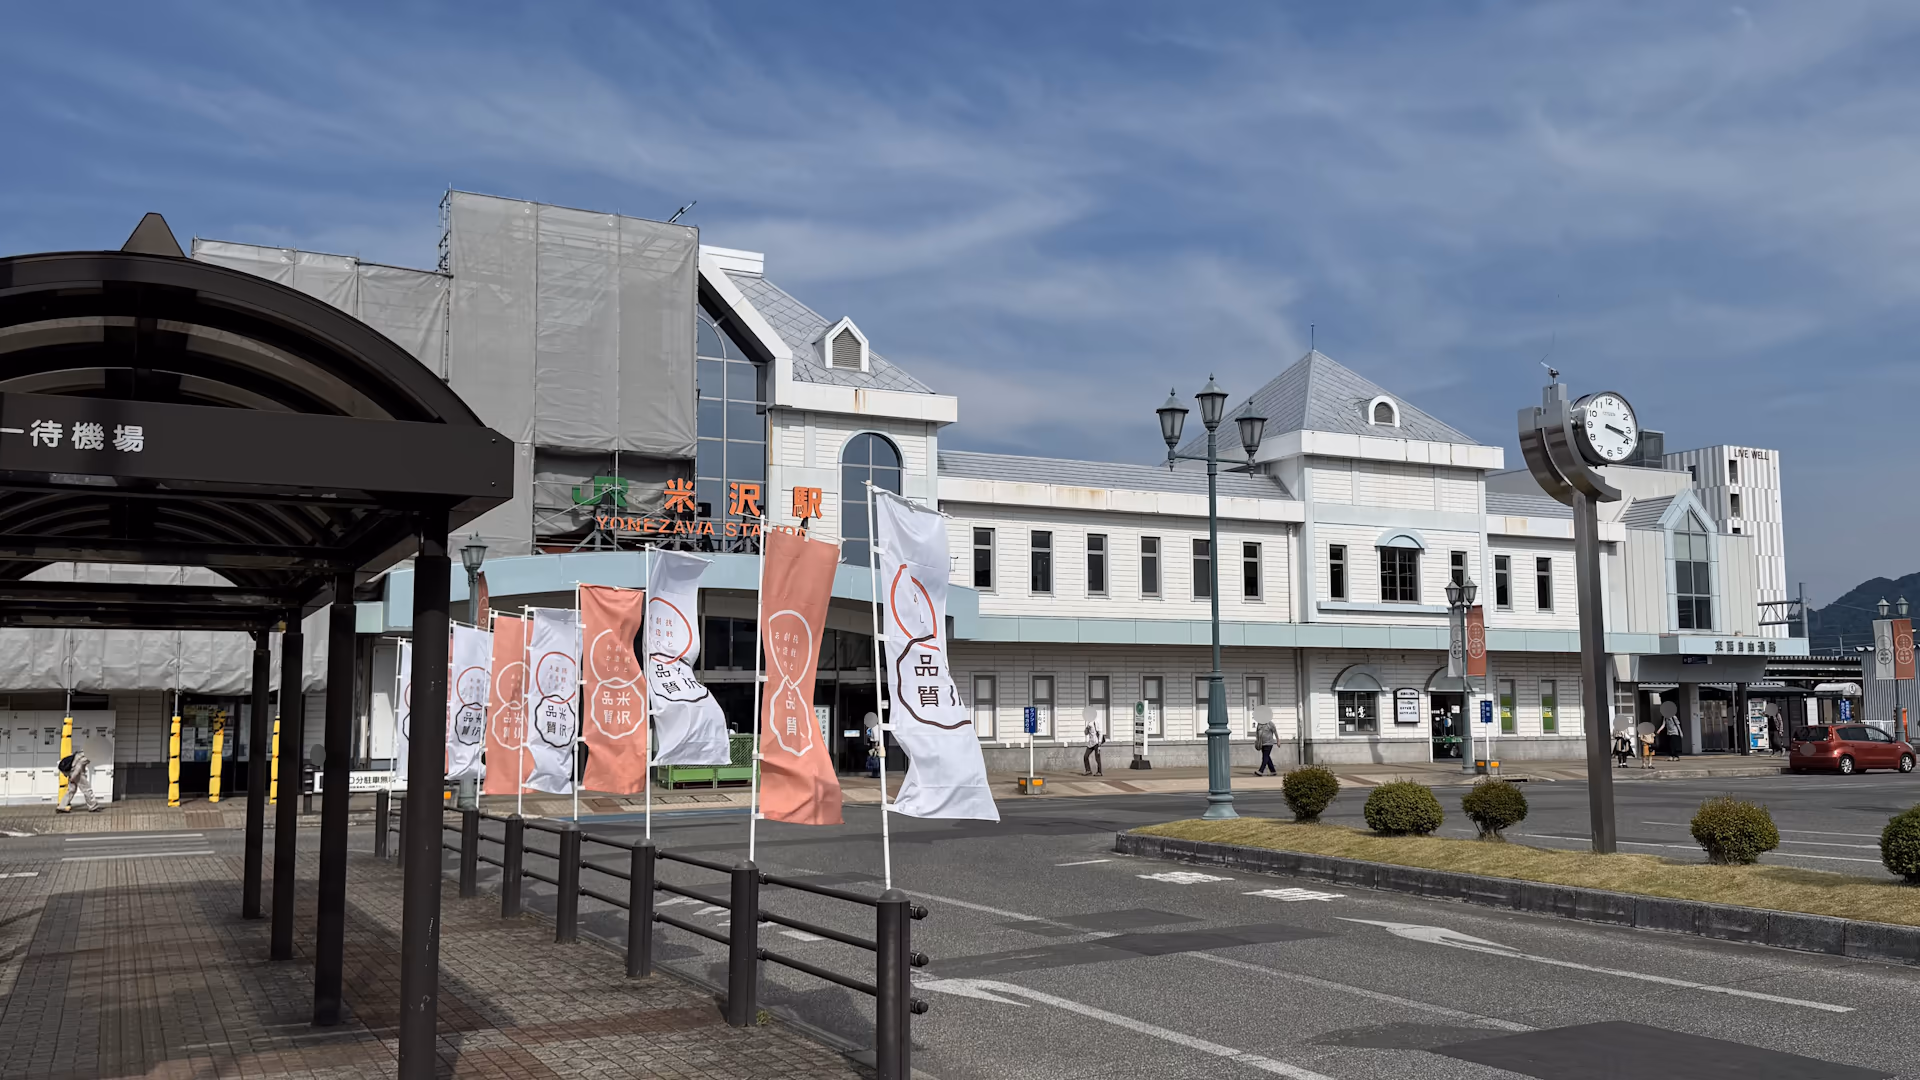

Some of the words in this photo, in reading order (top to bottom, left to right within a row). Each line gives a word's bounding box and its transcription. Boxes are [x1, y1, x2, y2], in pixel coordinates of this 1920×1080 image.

[1596, 401, 1603, 409] 11
[1605, 398, 1613, 406] 12
[1590, 410, 1597, 418] 10
[1587, 421, 1593, 429] 9
[1626, 427, 1632, 435] 3
[1590, 433, 1596, 441] 8
[1607, 450, 1613, 458] 6
[1617, 447, 1623, 455] 5
[1734, 449, 1749, 459] LIVE
[1751, 450, 1770, 461] WELL
[571, 475, 629, 508] JR
[663, 477, 823, 520] 米沢駅
[597, 515, 716, 537] YONEZAWA
[725, 522, 811, 538] STAION
[1715, 640, 1777, 653] 東西自由通路
[655, 663, 681, 695] 品質
[914, 654, 939, 708] 品質
[602, 690, 613, 725] 品質
[616, 691, 631, 726] 米沢
[545, 705, 557, 735] 品質
